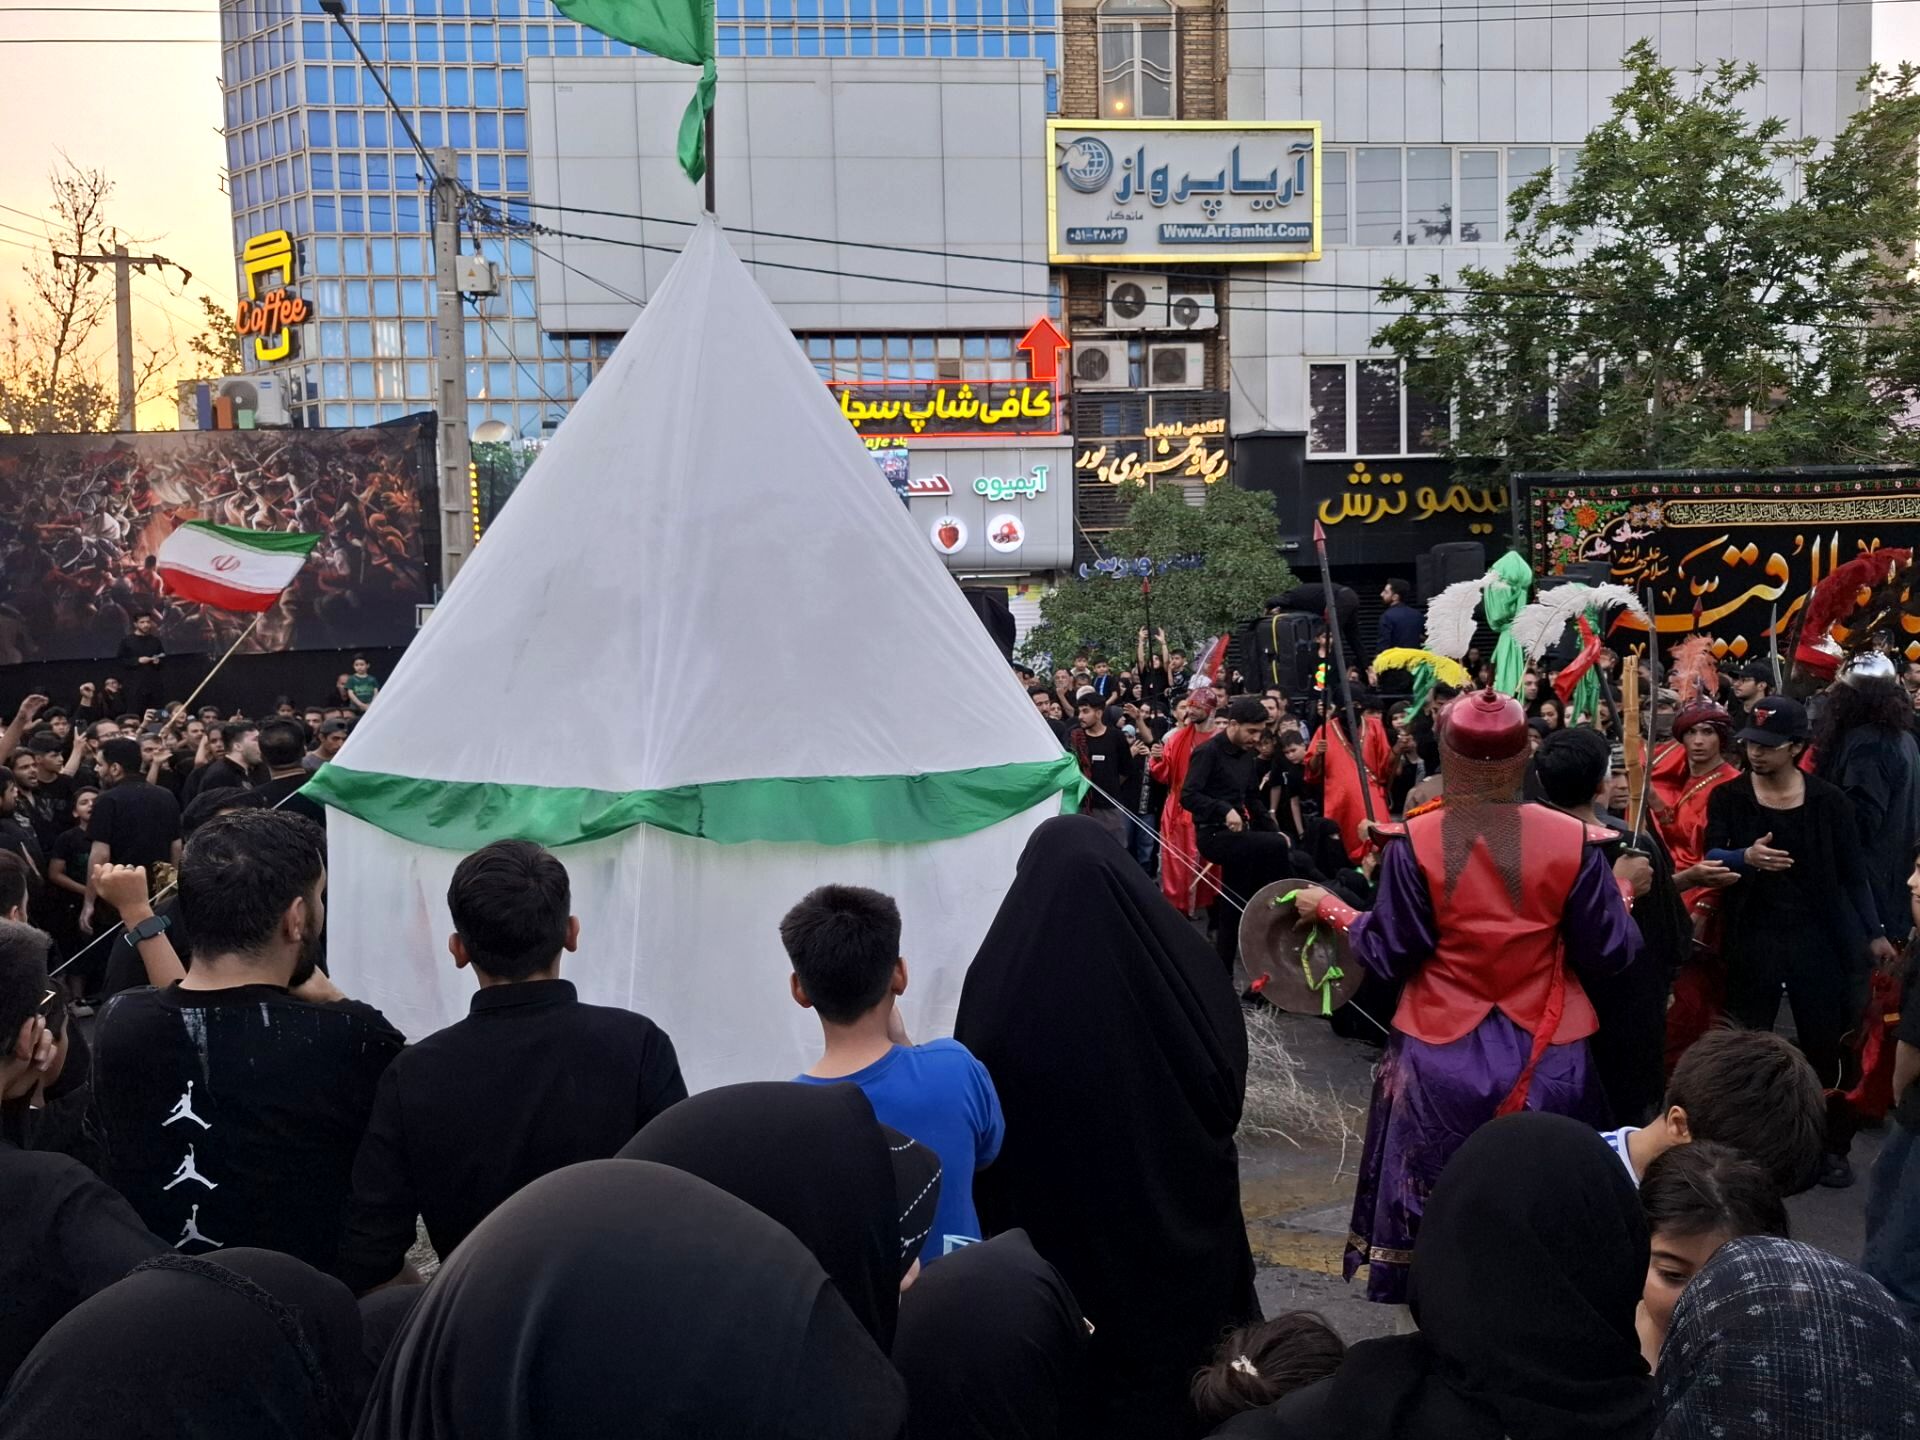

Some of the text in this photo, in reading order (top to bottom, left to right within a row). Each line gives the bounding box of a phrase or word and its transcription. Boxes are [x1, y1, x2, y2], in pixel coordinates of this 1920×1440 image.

[1113, 142, 1314, 220] آریا پرواز
[1163, 224, 1310, 239] Www.Ariamhd.Com
[236, 287, 306, 335] Coffee
[841, 384, 1051, 433] کافی شاپ سجا
[865, 436, 890, 451] afe
[972, 464, 1049, 502] آبمیوه
[1316, 461, 1410, 526] ترش
